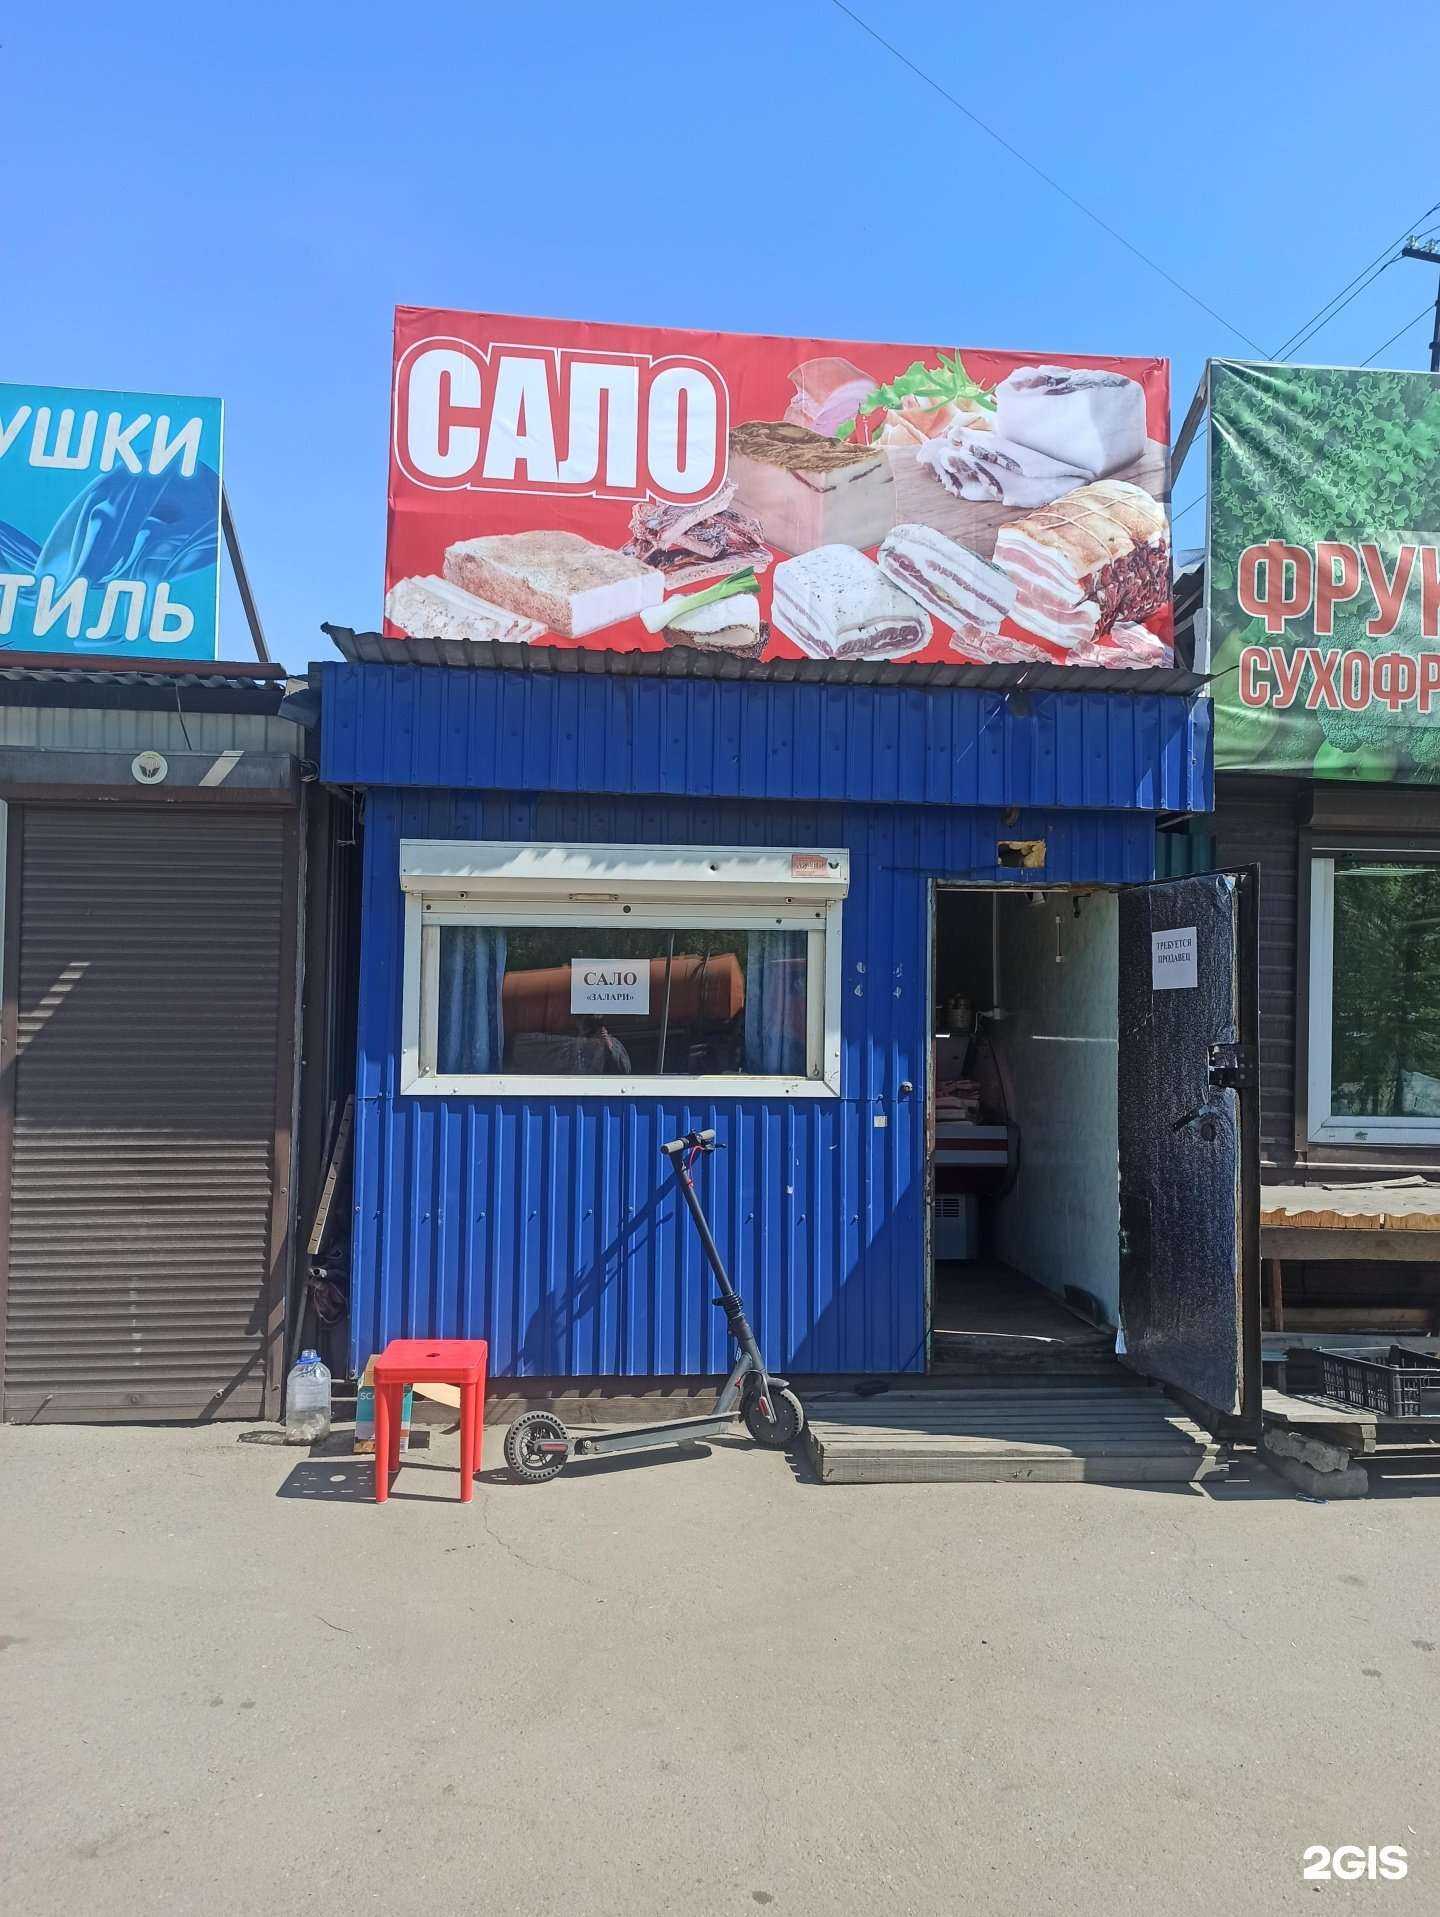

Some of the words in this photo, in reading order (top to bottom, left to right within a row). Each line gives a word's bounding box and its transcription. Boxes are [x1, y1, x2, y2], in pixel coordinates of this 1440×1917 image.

[0, 405, 203, 478] УШКИ
[405, 346, 719, 496] САЛО
[0, 572, 195, 643] ТИЛЬ
[1238, 645, 1440, 714] СУХОФР
[583, 971, 638, 986] САЛО
